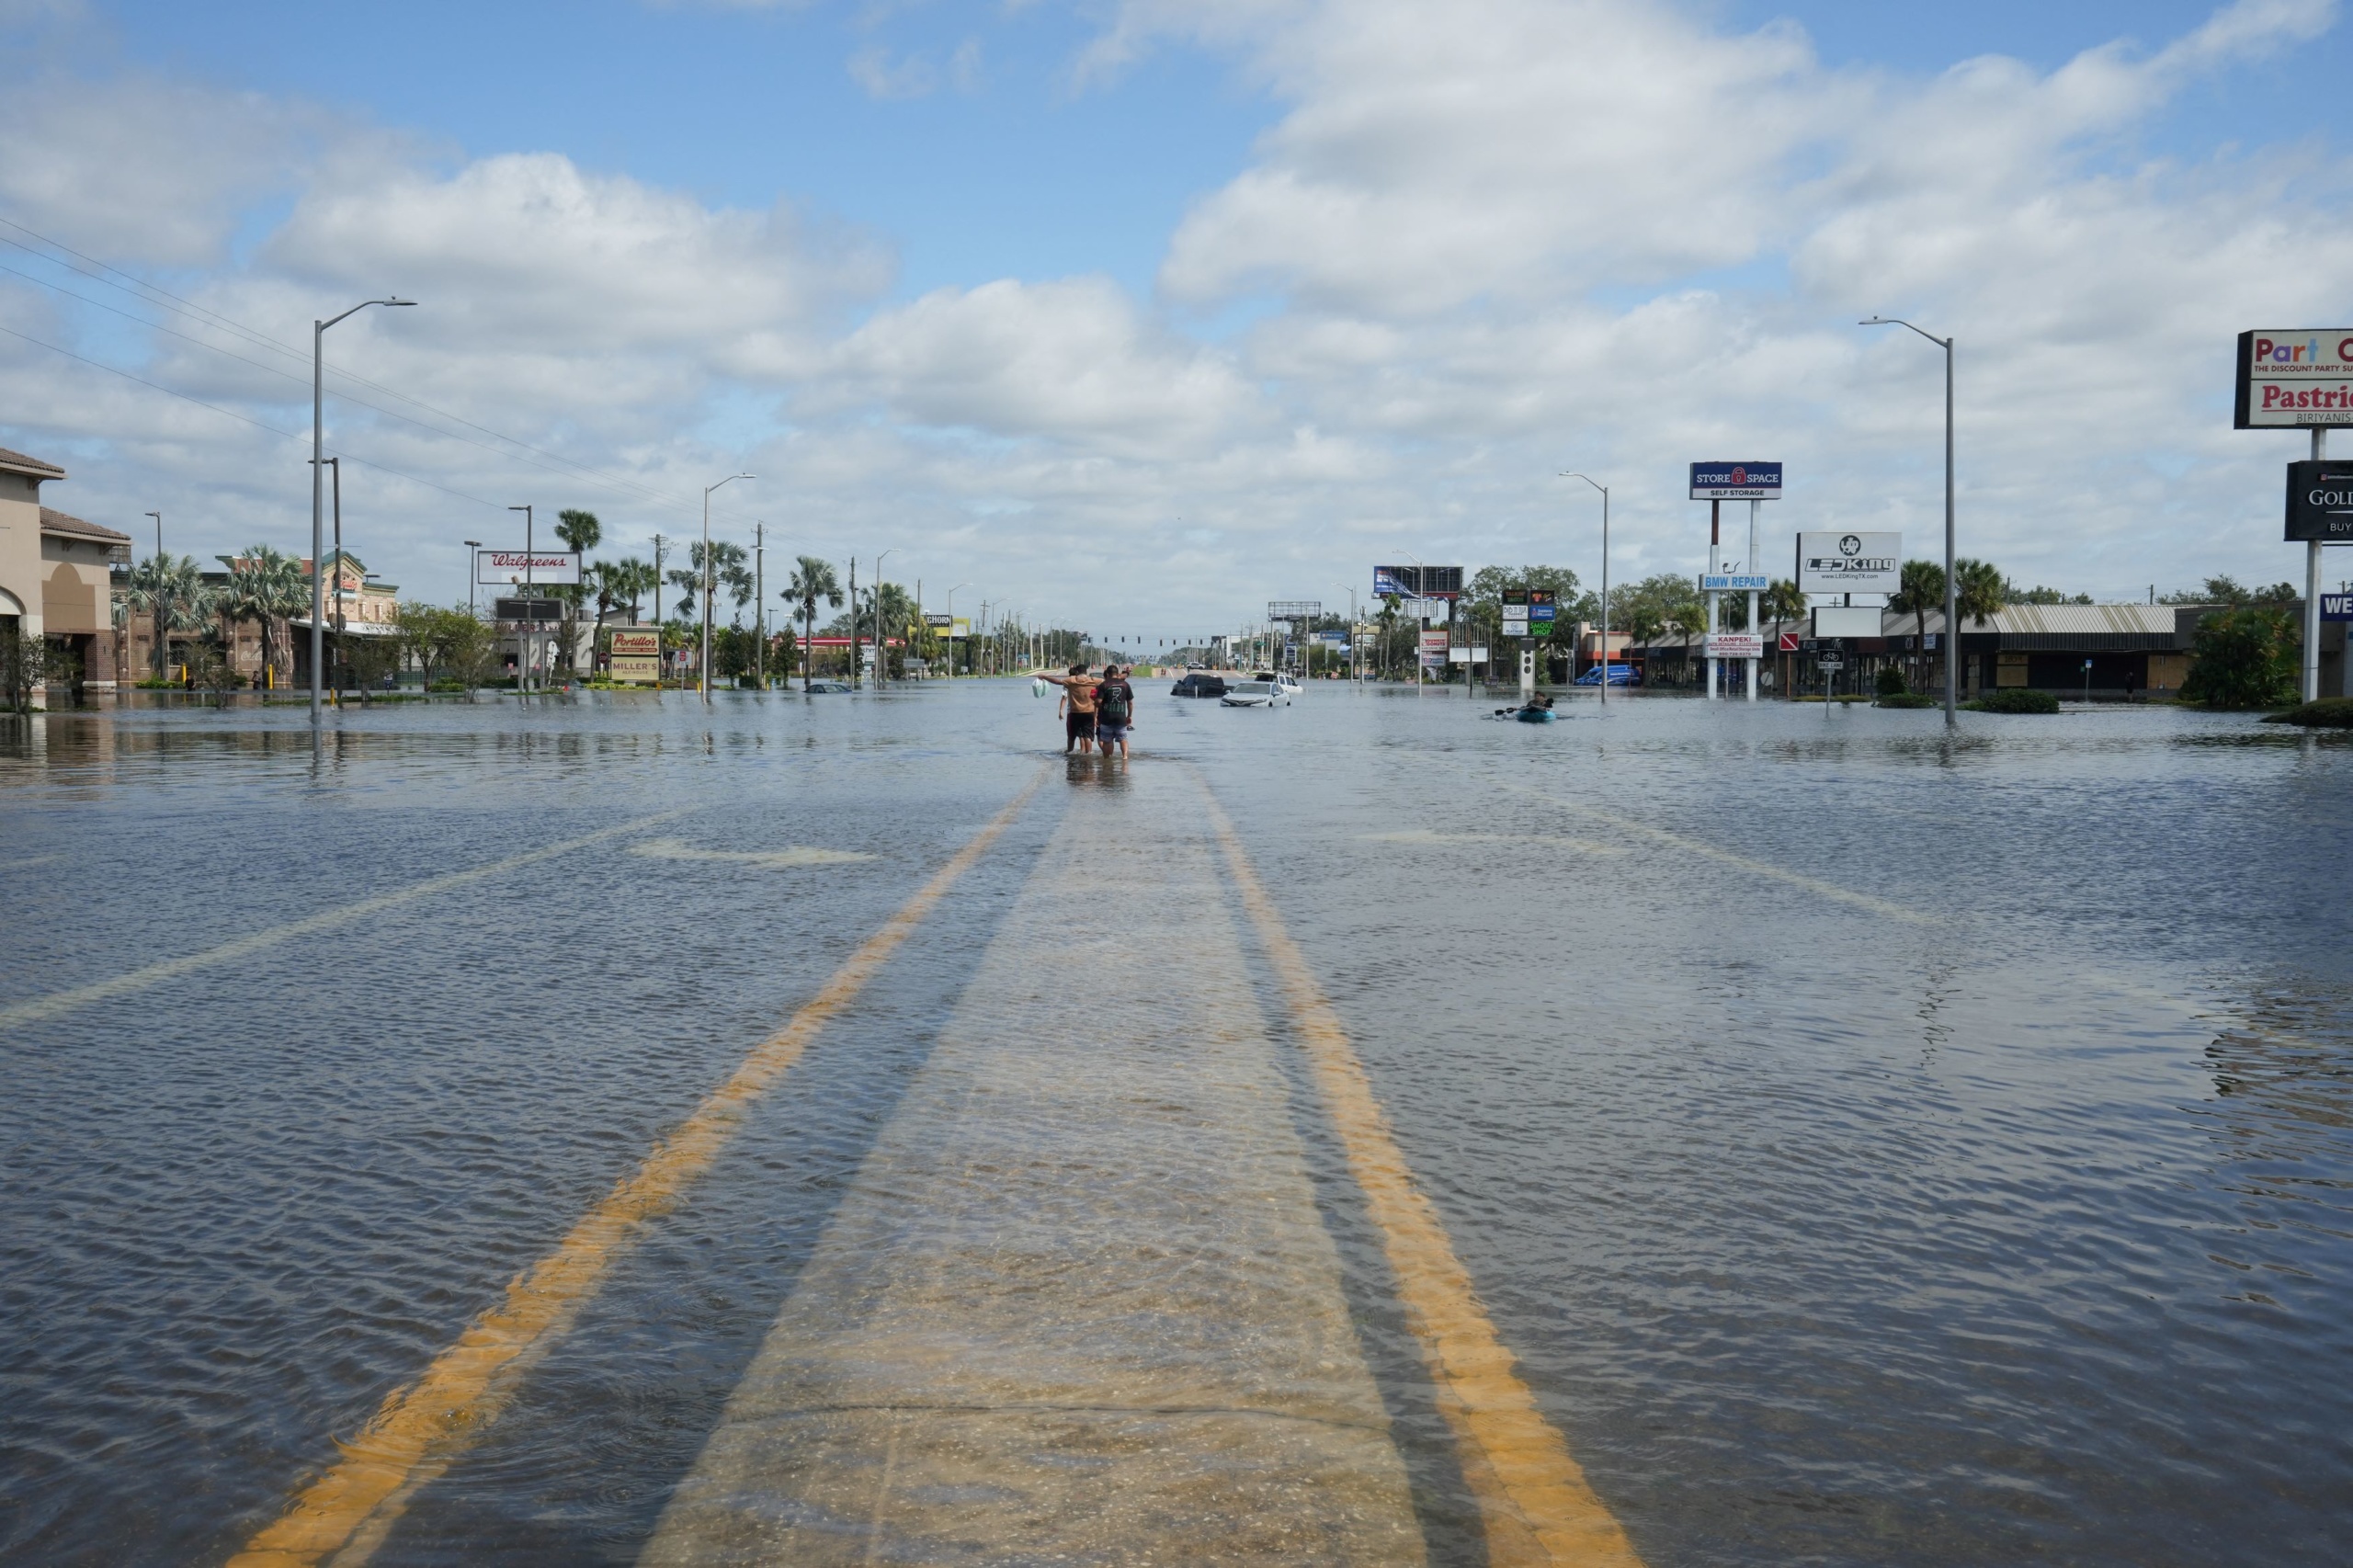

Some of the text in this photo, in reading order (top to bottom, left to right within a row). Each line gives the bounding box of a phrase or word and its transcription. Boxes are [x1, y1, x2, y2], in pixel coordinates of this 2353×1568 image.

[2256, 338, 2318, 362] Part
[1696, 474, 1779, 483] STORE SPACE
[2329, 523, 2352, 531] BUY
[491, 553, 566, 571] Walgreens
[1705, 576, 1767, 587] BMW REPAIR
[926, 616, 951, 624] GHORN
[614, 634, 656, 647] Portillo's
